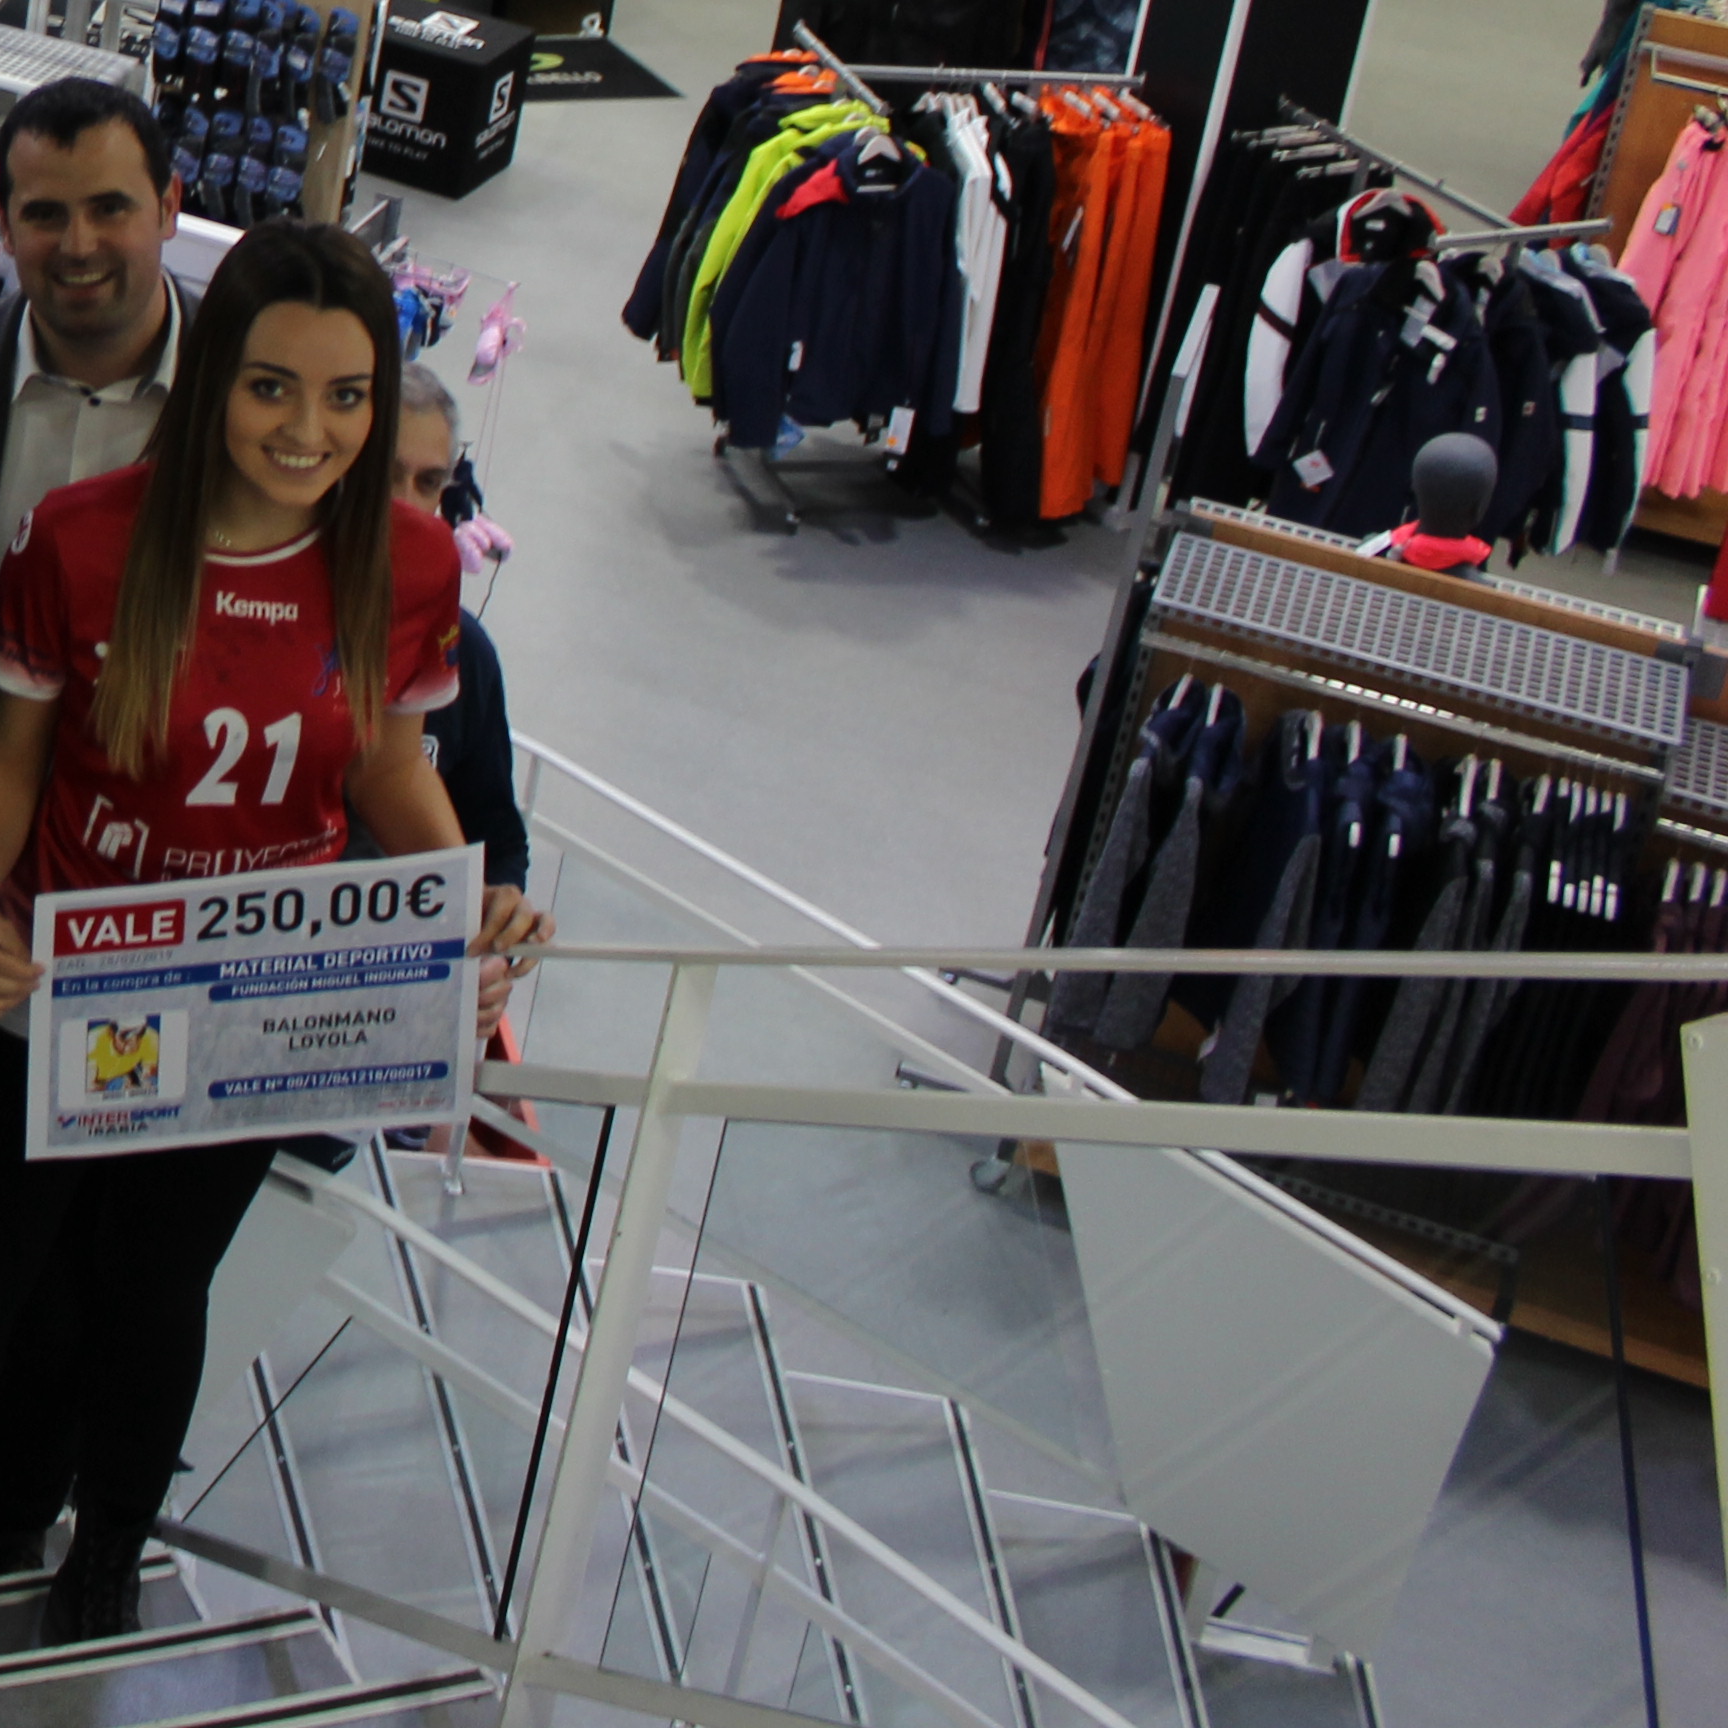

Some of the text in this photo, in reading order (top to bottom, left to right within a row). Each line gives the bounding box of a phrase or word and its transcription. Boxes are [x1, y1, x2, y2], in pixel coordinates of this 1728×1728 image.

[215, 589, 299, 626] Kempa
[185, 706, 302, 807] 21
[68, 873, 447, 949] VALE 250,00€
[219, 943, 433, 981] MATERIAL DEPORTIVO
[262, 1007, 397, 1035] BALONMANO
[288, 1030, 368, 1052] LOYOLA
[225, 1080, 264, 1096] VALE
[77, 1105, 183, 1129] INTERSPORT
